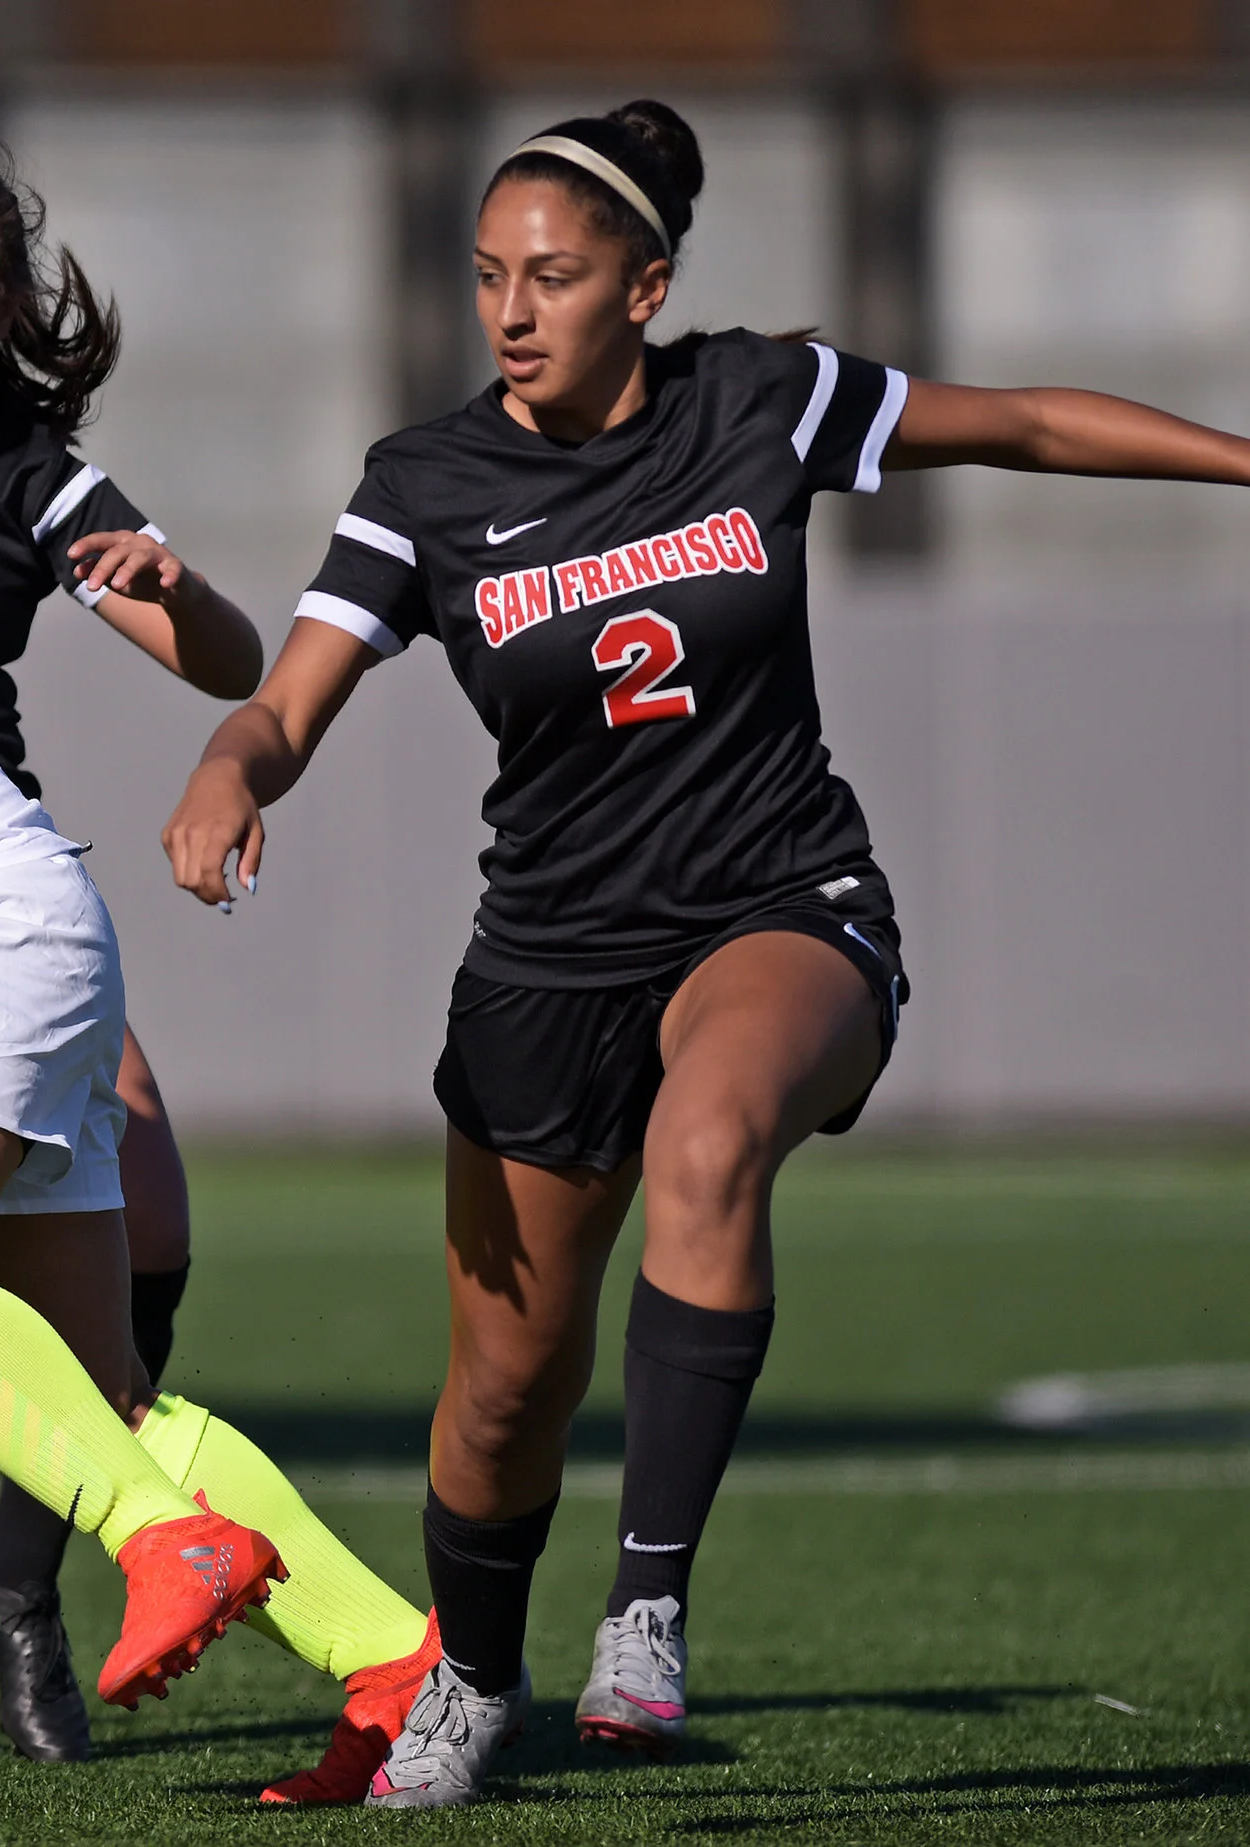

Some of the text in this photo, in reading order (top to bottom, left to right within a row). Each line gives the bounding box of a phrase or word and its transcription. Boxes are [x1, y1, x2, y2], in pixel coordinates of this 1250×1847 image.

[474, 506, 769, 649] SAN FRANCISCO
[591, 608, 697, 729] 2
[213, 1542, 235, 1600] adidas
